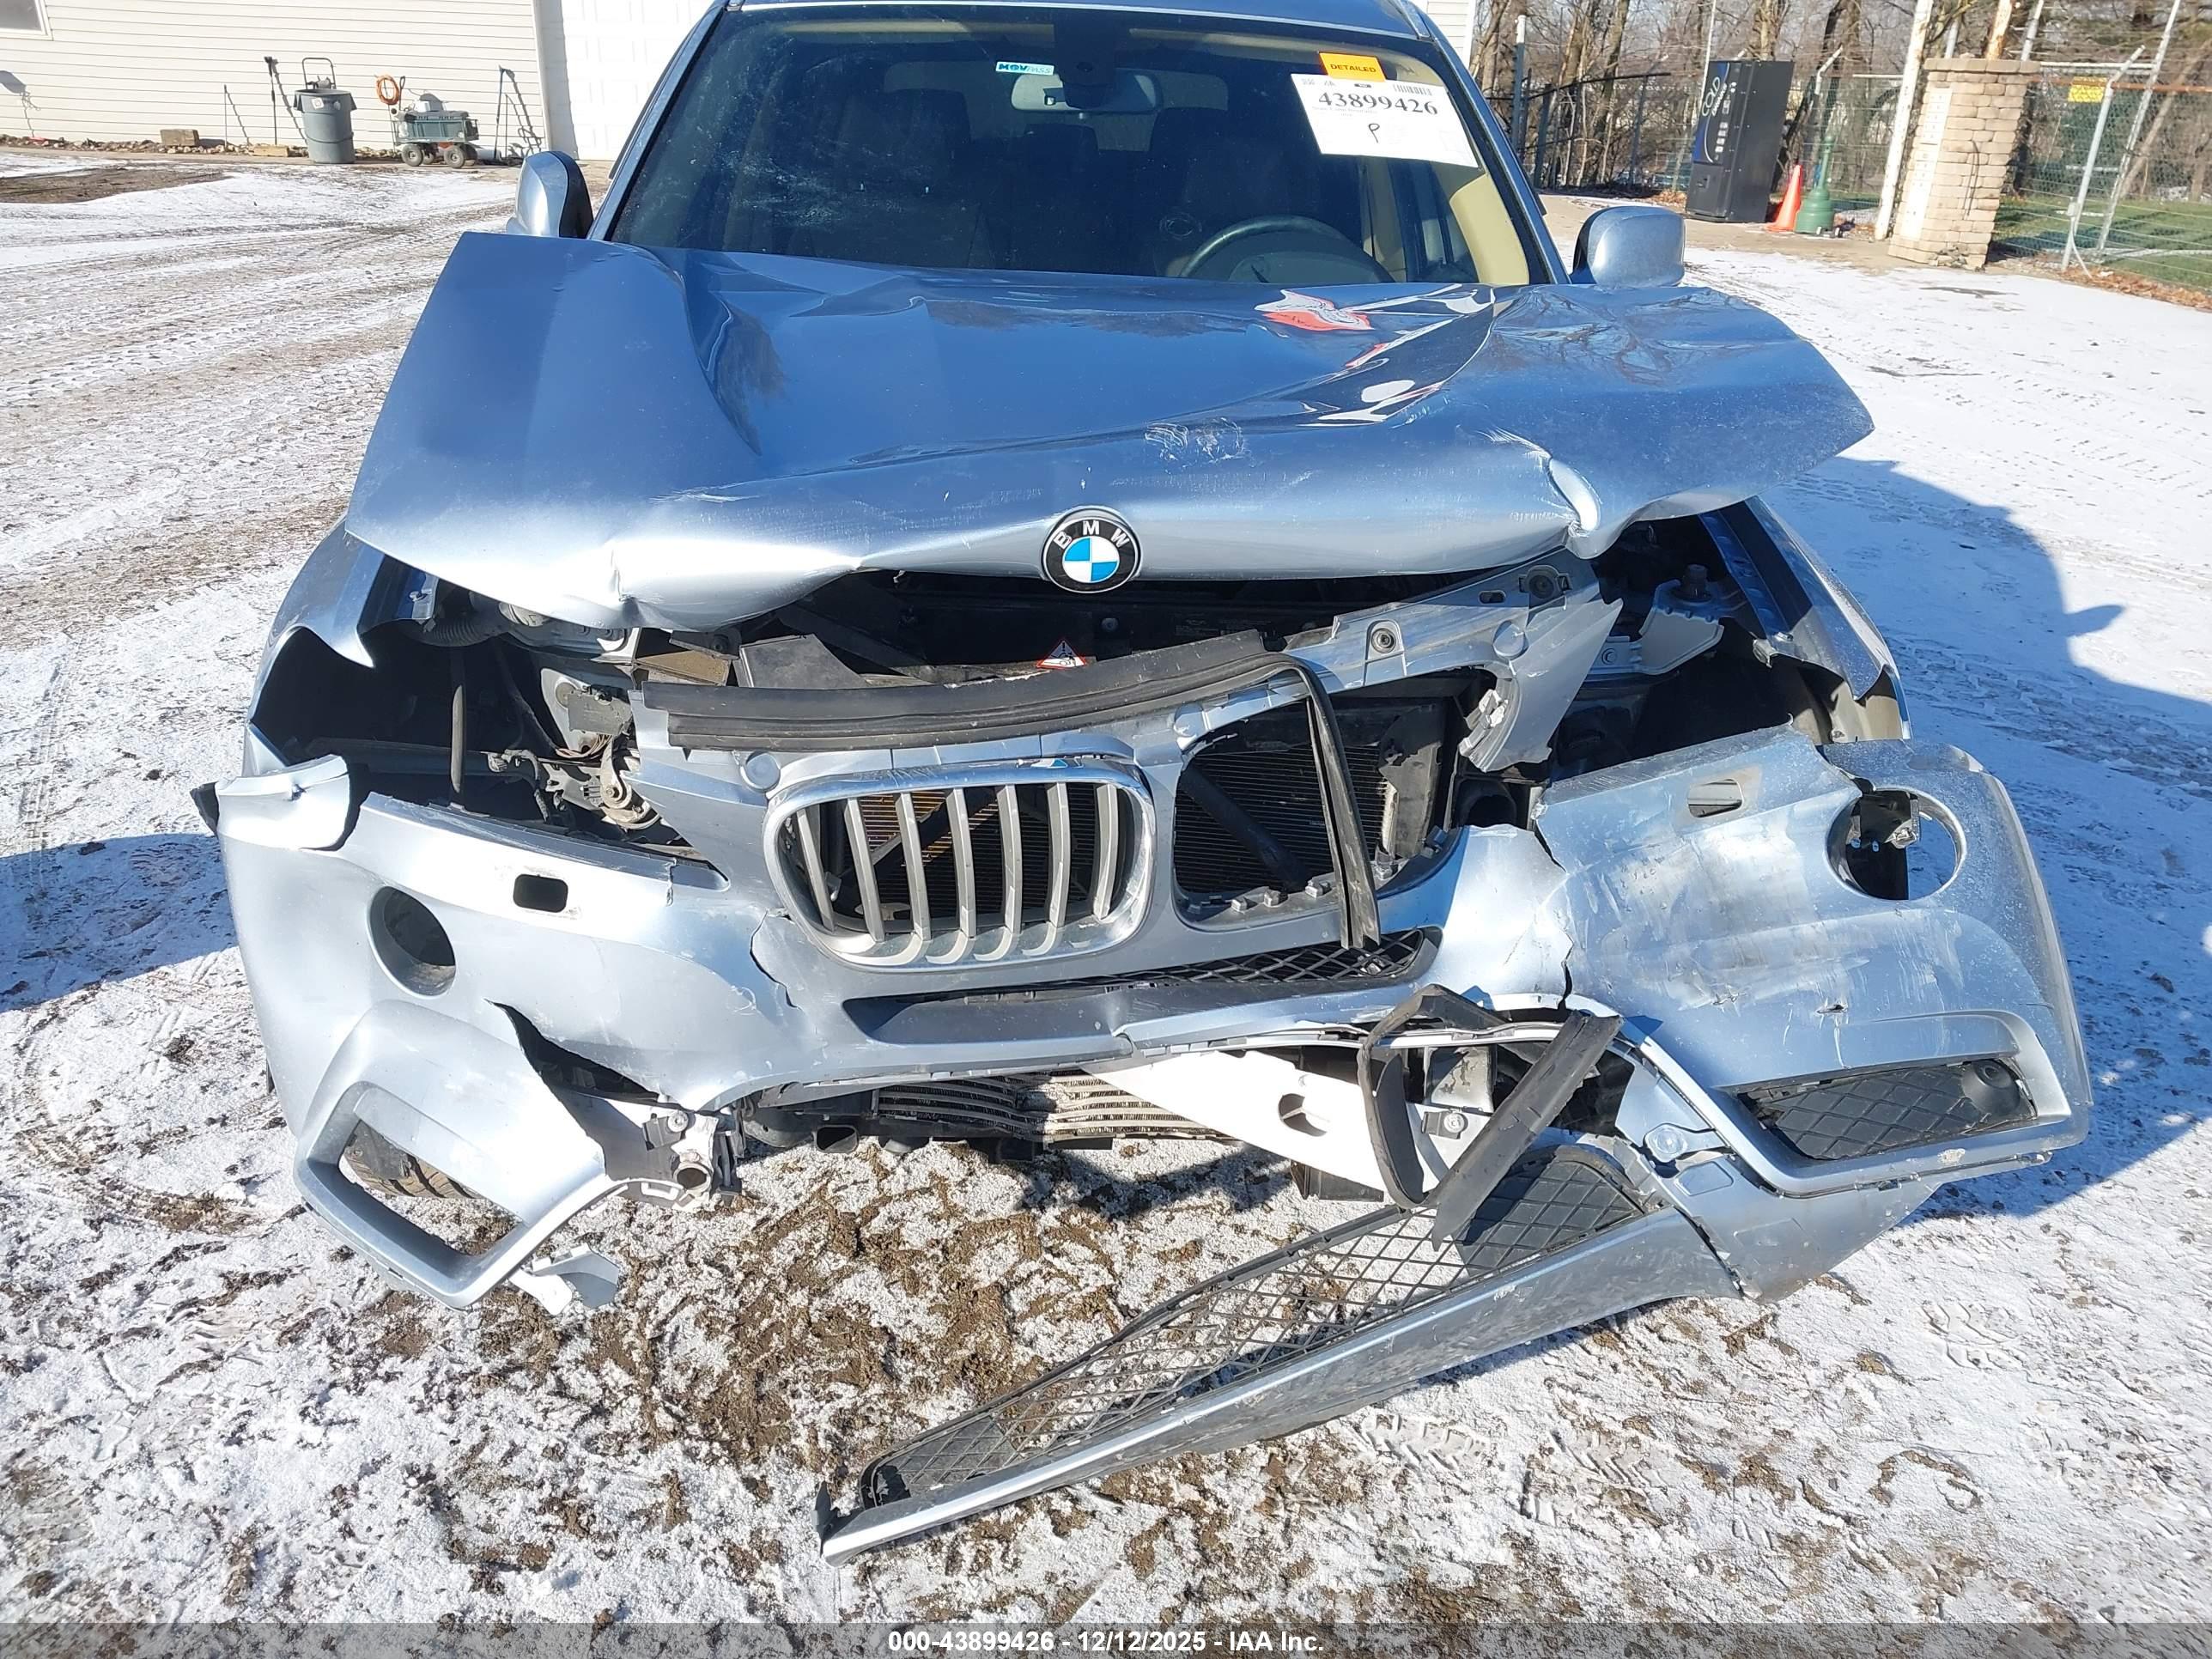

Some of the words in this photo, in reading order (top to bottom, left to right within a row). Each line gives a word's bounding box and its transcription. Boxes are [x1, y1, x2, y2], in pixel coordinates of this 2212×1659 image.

[1330, 64, 1376, 73] DETAILED
[1318, 92, 1438, 115] 43899426
[1702, 77, 1721, 116] COLD
[1053, 520, 1130, 550] BMW
